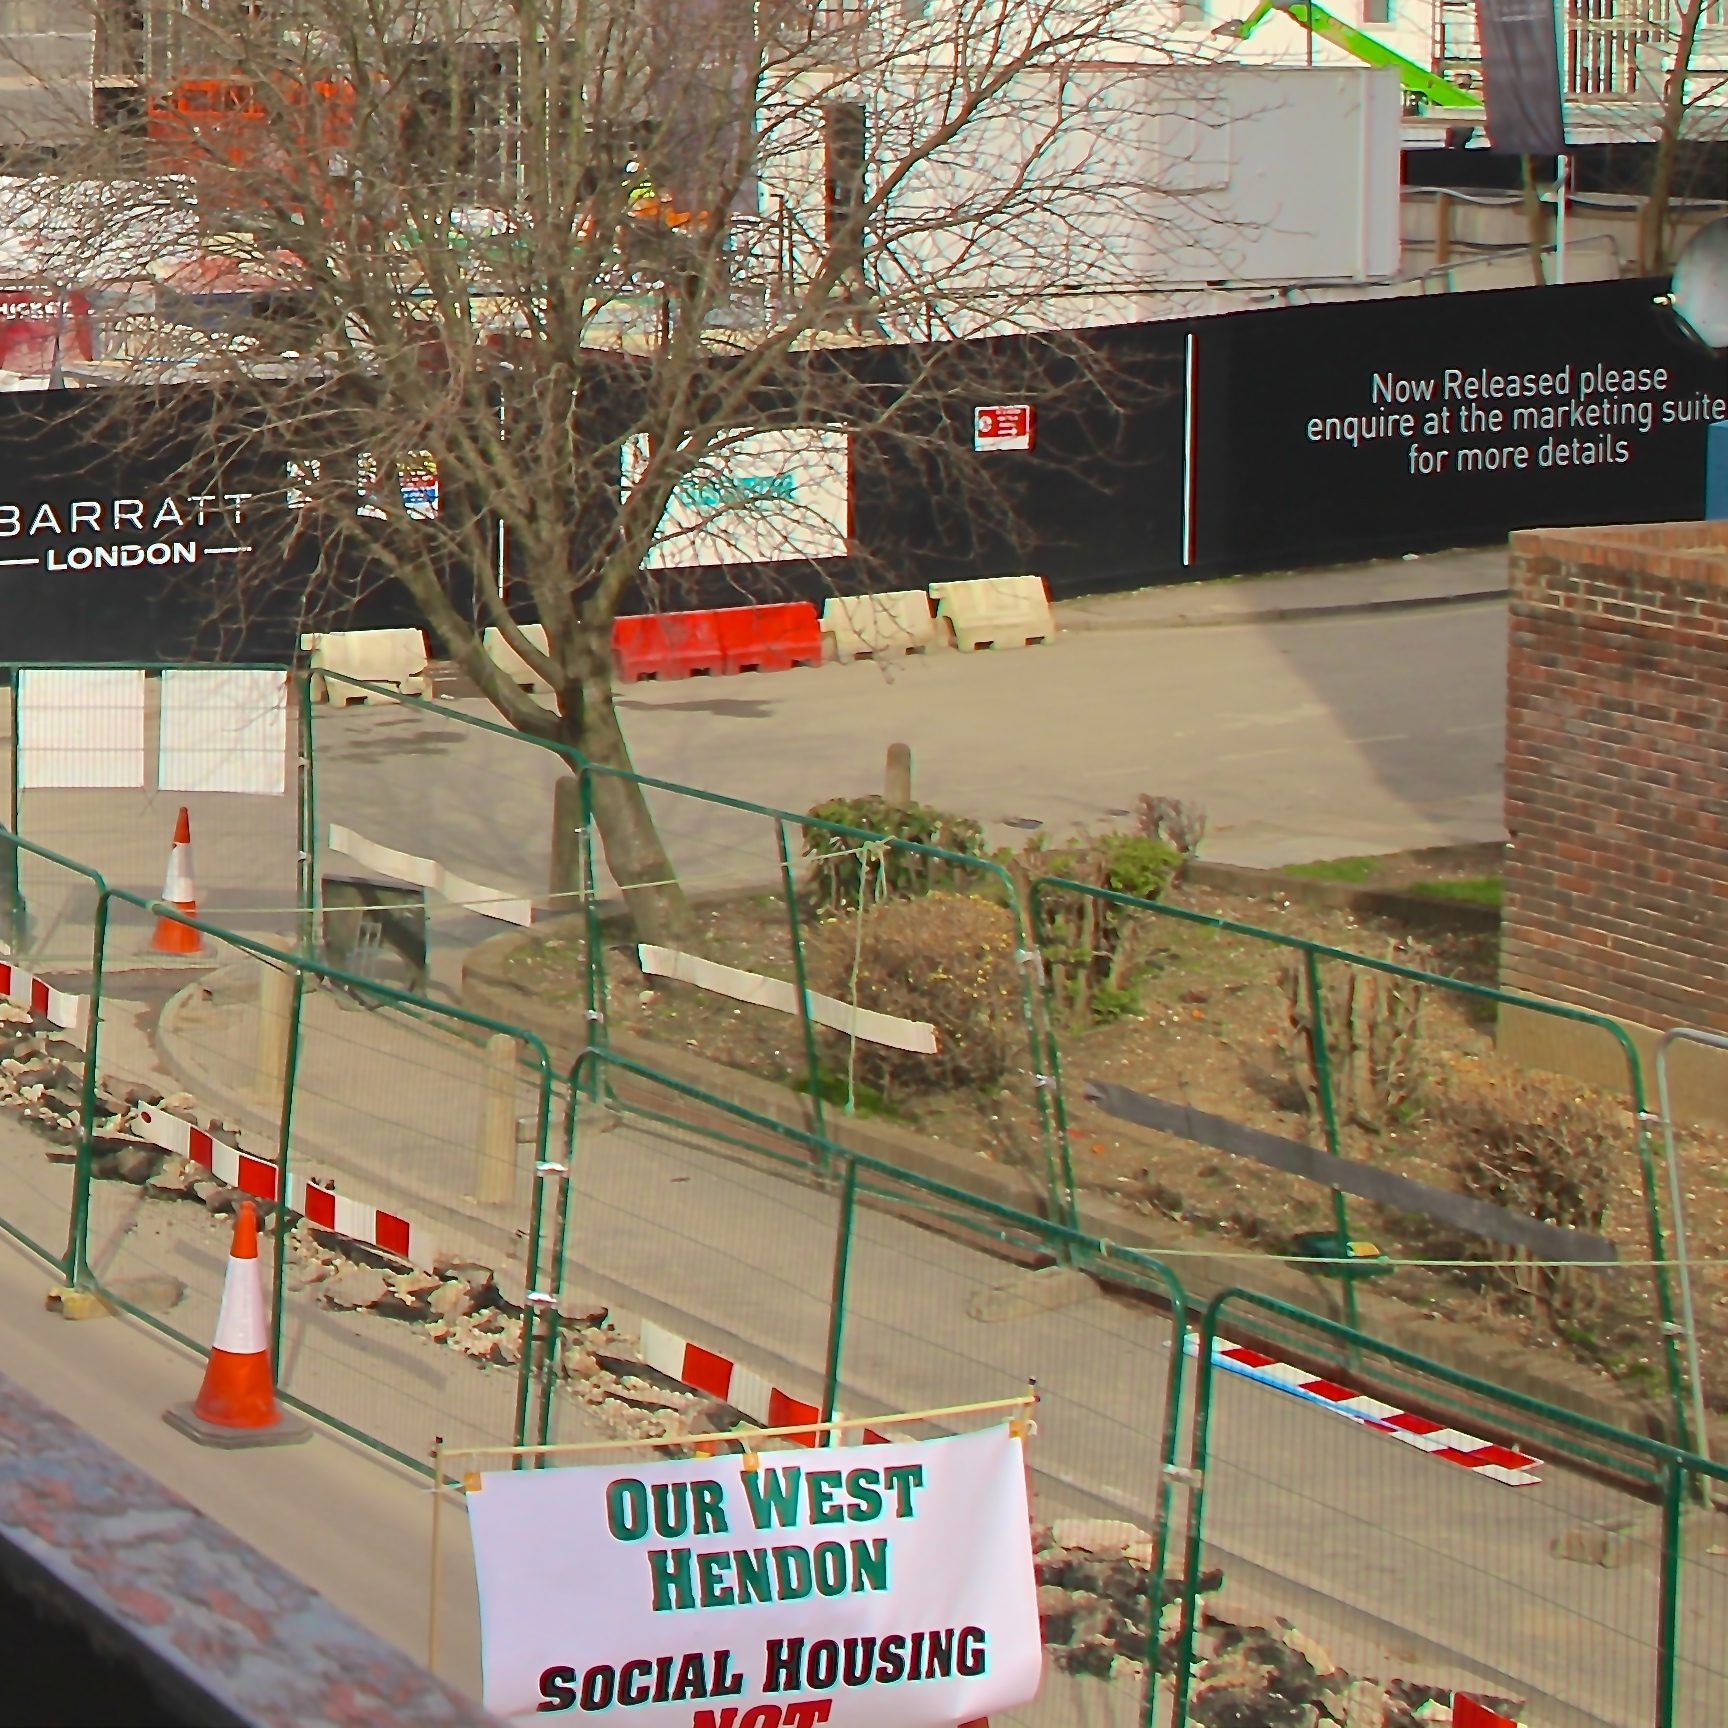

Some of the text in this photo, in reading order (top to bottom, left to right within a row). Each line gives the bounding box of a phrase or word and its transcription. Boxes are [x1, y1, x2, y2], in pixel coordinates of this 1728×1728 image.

[1371, 363, 1669, 404] Now Released please
[1306, 391, 1727, 448] enquire at the marketing suite
[1407, 433, 1631, 475] for more details
[46, 541, 197, 571] LONDON
[605, 1463, 924, 1542] OUR WEST
[647, 1537, 889, 1613] HENDON
[535, 1625, 988, 1713] SOCIAL HOUSING
